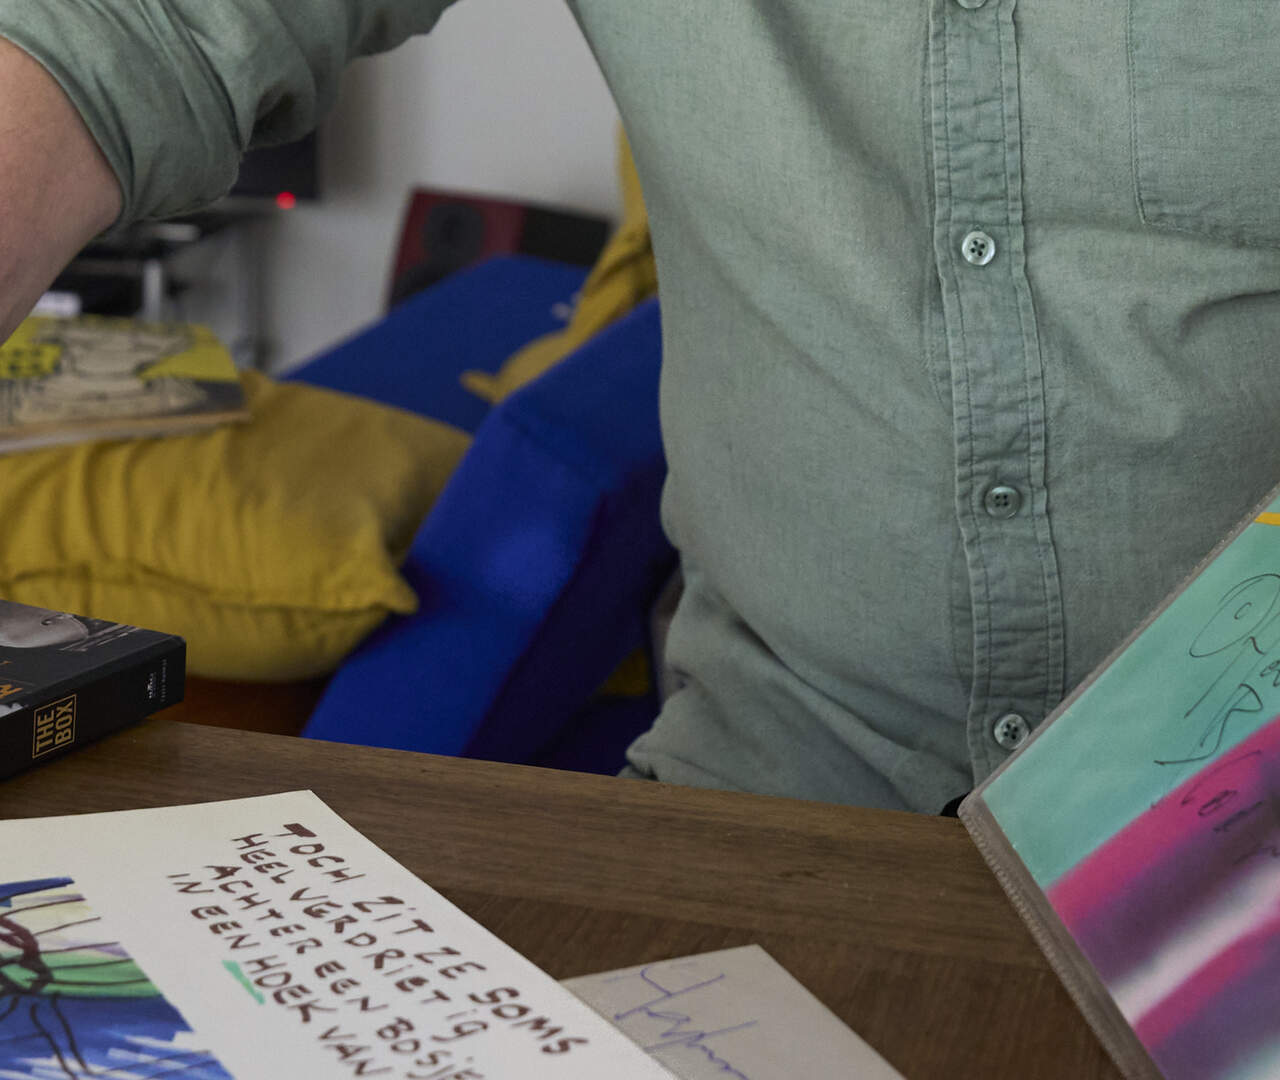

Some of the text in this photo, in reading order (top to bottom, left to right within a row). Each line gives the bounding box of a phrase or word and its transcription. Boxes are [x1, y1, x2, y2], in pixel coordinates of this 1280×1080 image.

[36, 709, 55, 753] THE
[55, 701, 73, 745] BOX
[232, 833, 295, 884] HEEL
[166, 873, 393, 1077] IN EEN HOEK VAN
[203, 864, 323, 955] ACHTER
[314, 960, 390, 1012] EEN
[273, 822, 366, 884] TOCH
[413, 946, 487, 980] ZE
[467, 986, 590, 1055] SOMS
